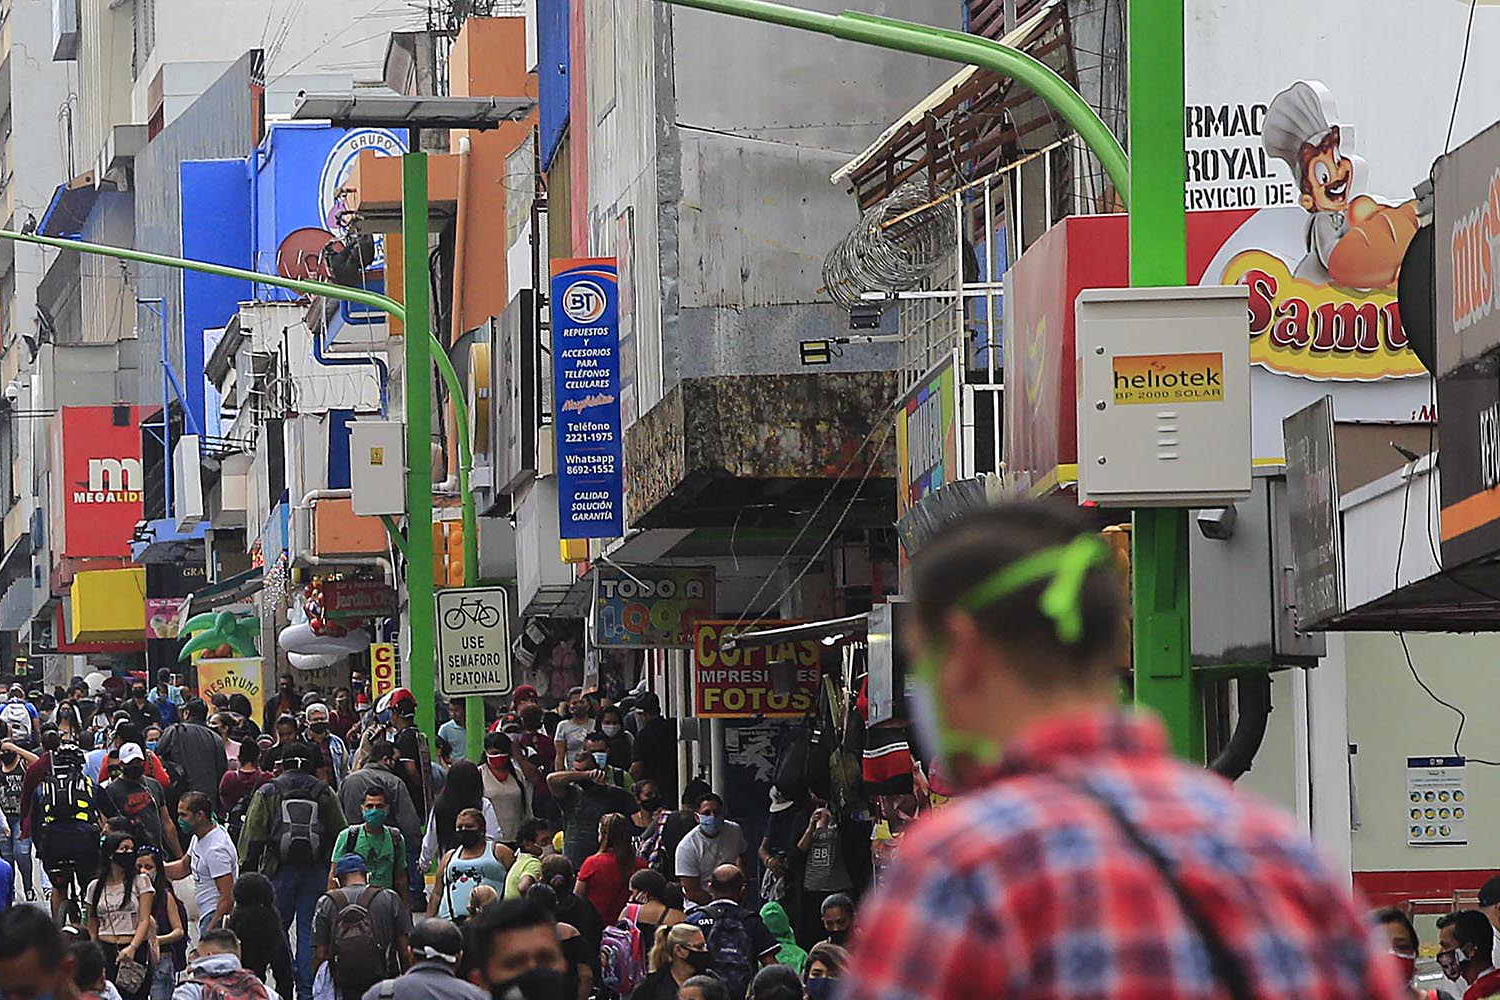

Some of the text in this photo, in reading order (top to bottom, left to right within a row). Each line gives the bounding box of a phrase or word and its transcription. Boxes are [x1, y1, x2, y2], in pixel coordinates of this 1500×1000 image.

[350, 134, 393, 150] GRUPO
[1185, 147, 1276, 182] ROYAL
[1265, 184, 1293, 205] DE
[570, 293, 593, 312] BT
[563, 327, 609, 337] REPUESTOS
[583, 338, 589, 347] Y
[561, 348, 611, 358] ACCESORIOS
[576, 359, 598, 368] PARA
[564, 368, 610, 379] TELÉFONOS
[1113, 368, 1221, 389] heliotek
[565, 379, 610, 389] CELULARES
[1115, 388, 1221, 400] BP 2000 SOLAR
[567, 422, 610, 432] Teléfono
[565, 433, 613, 442] 2221-1975
[565, 454, 614, 464] Whatsapp
[566, 465, 614, 475] 8692-1552
[574, 491, 609, 500] CALIDAD
[571, 501, 612, 511] SOLUCIÓN
[571, 511, 613, 521] GARANTÍA
[602, 579, 677, 599] TODO
[461, 636, 485, 650] USE
[448, 652, 501, 668] SEMAFORO
[449, 671, 501, 685] PEATONAL
[697, 669, 819, 683] IMPRESIES
[703, 687, 811, 710] FOTOS
